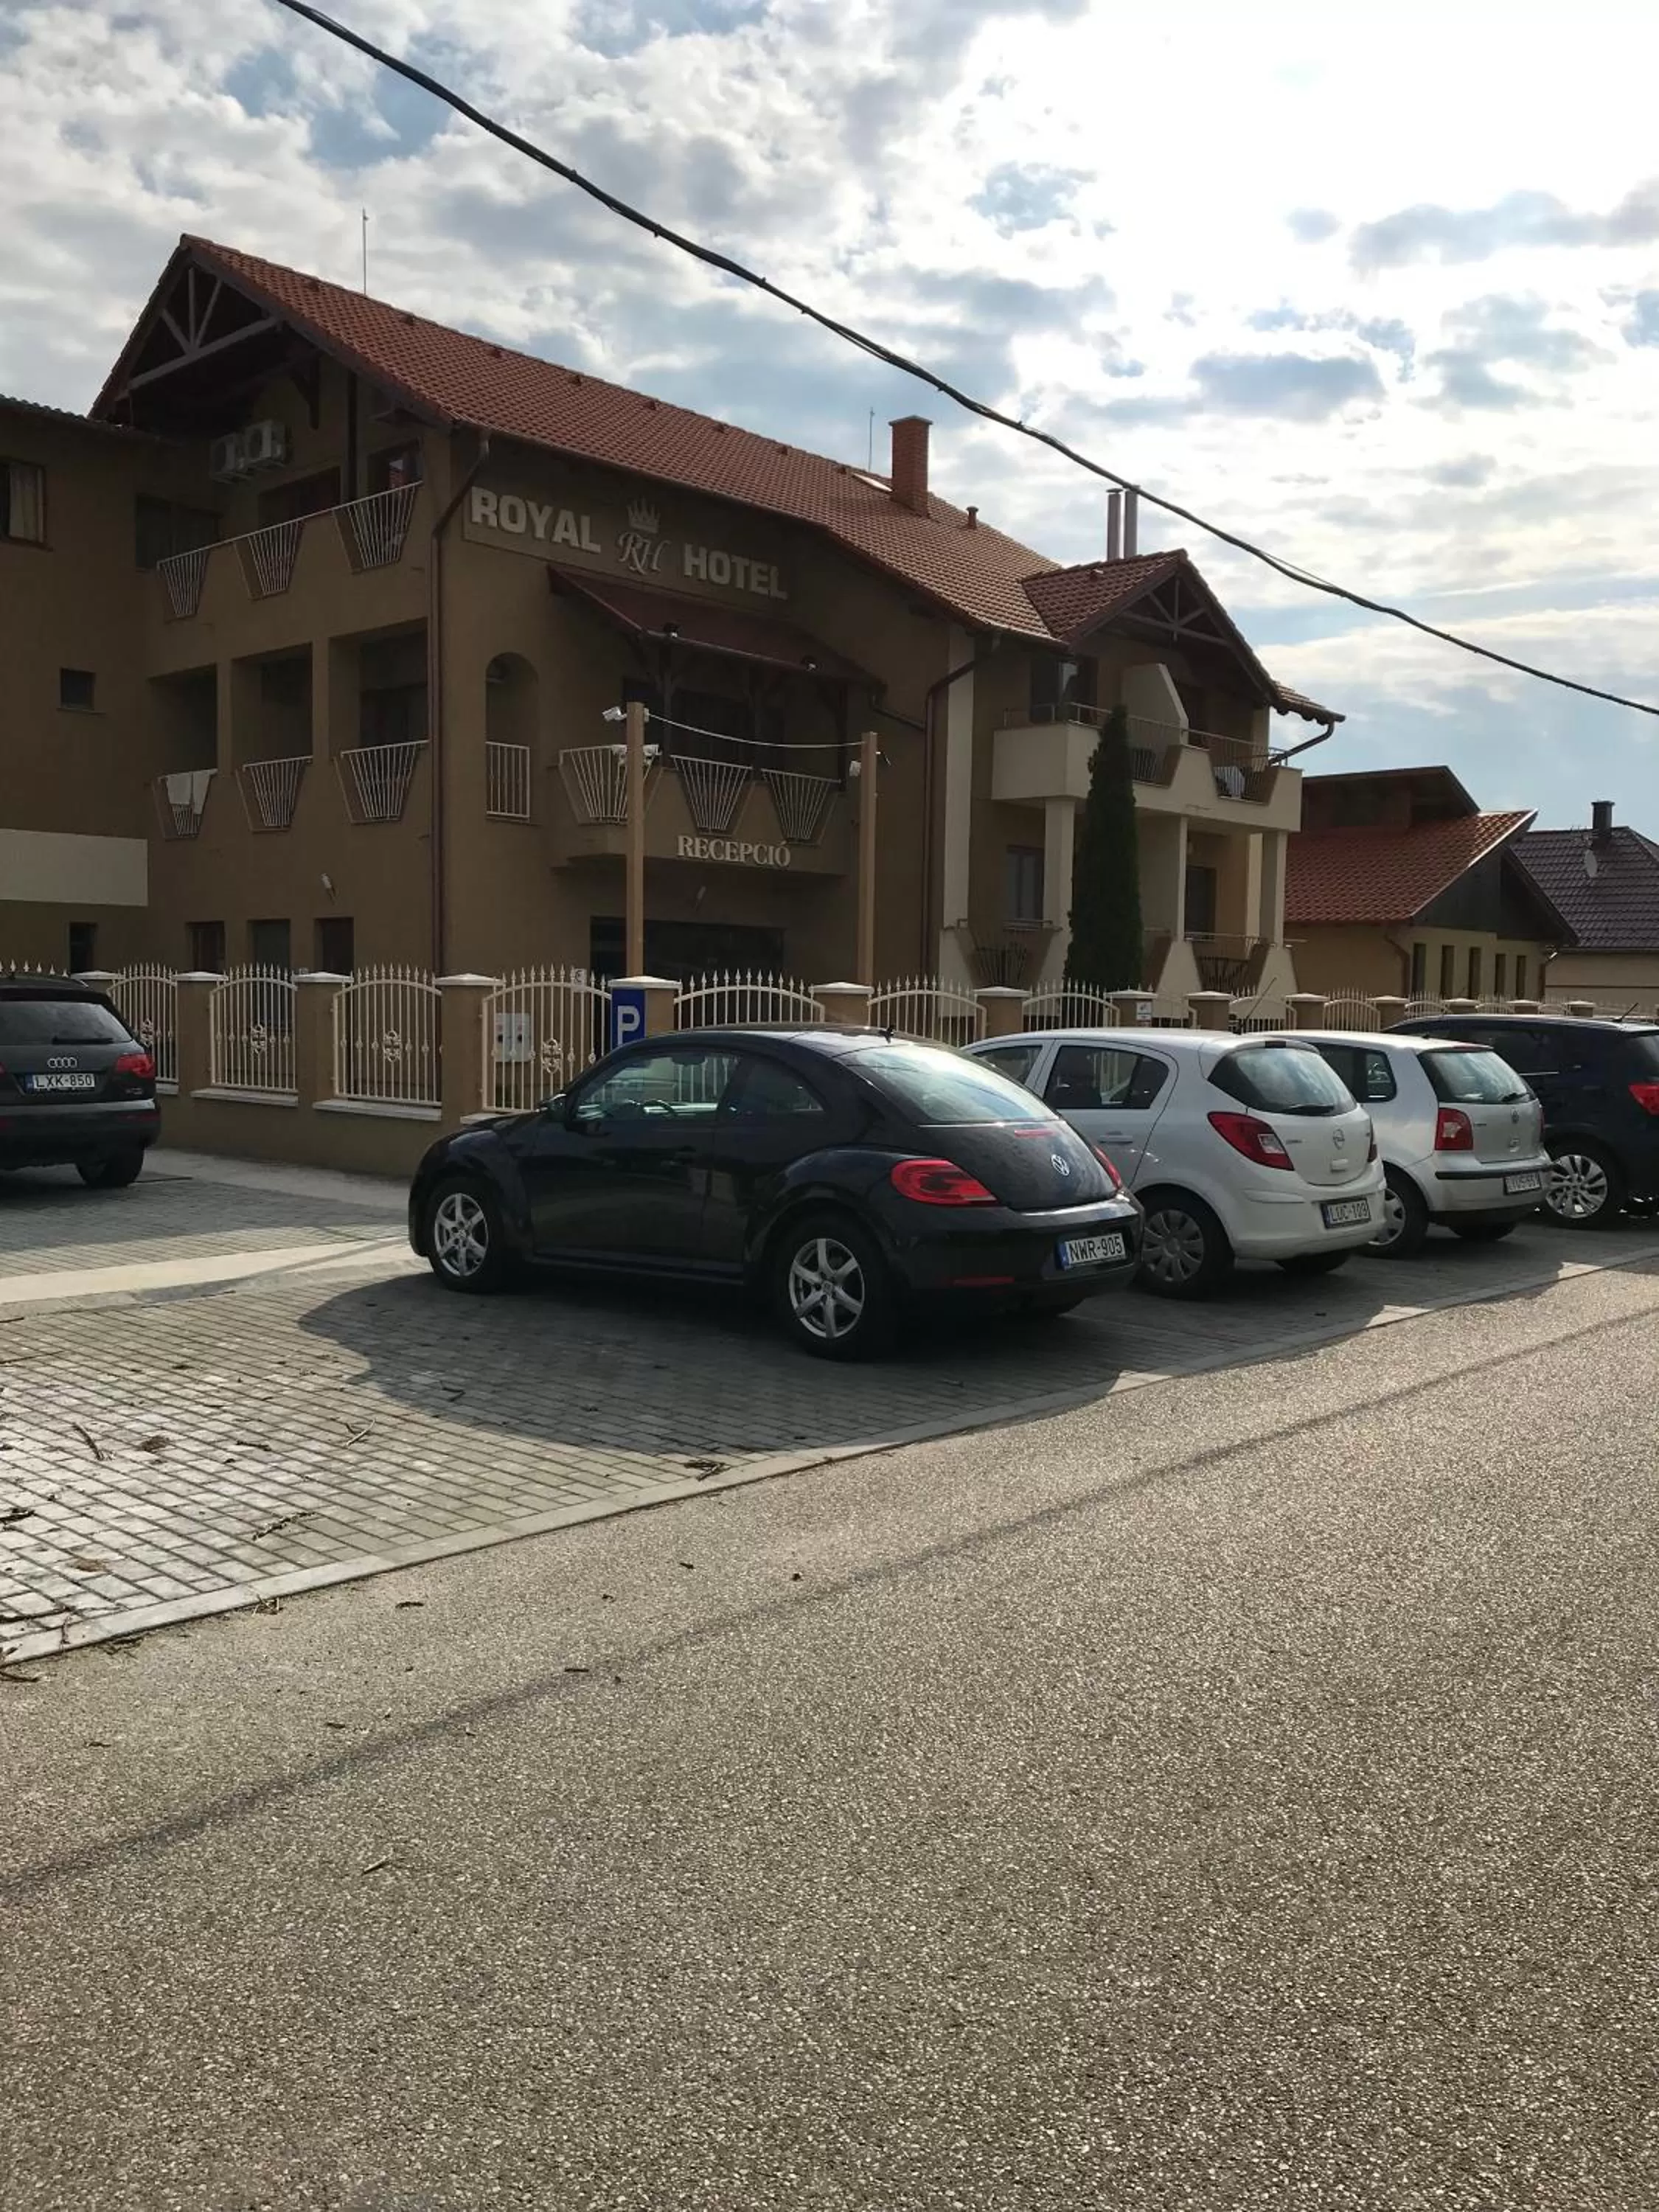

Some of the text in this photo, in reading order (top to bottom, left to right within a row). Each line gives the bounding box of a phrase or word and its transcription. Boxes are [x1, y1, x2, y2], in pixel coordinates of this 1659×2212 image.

[470, 486, 789, 602] ROYAL HOTEL
[678, 835, 791, 866] RECEPCIÓ
[617, 1005, 641, 1047] P
[36, 1074, 92, 1088] LXK-850
[1070, 1235, 1123, 1262] NWR-905
